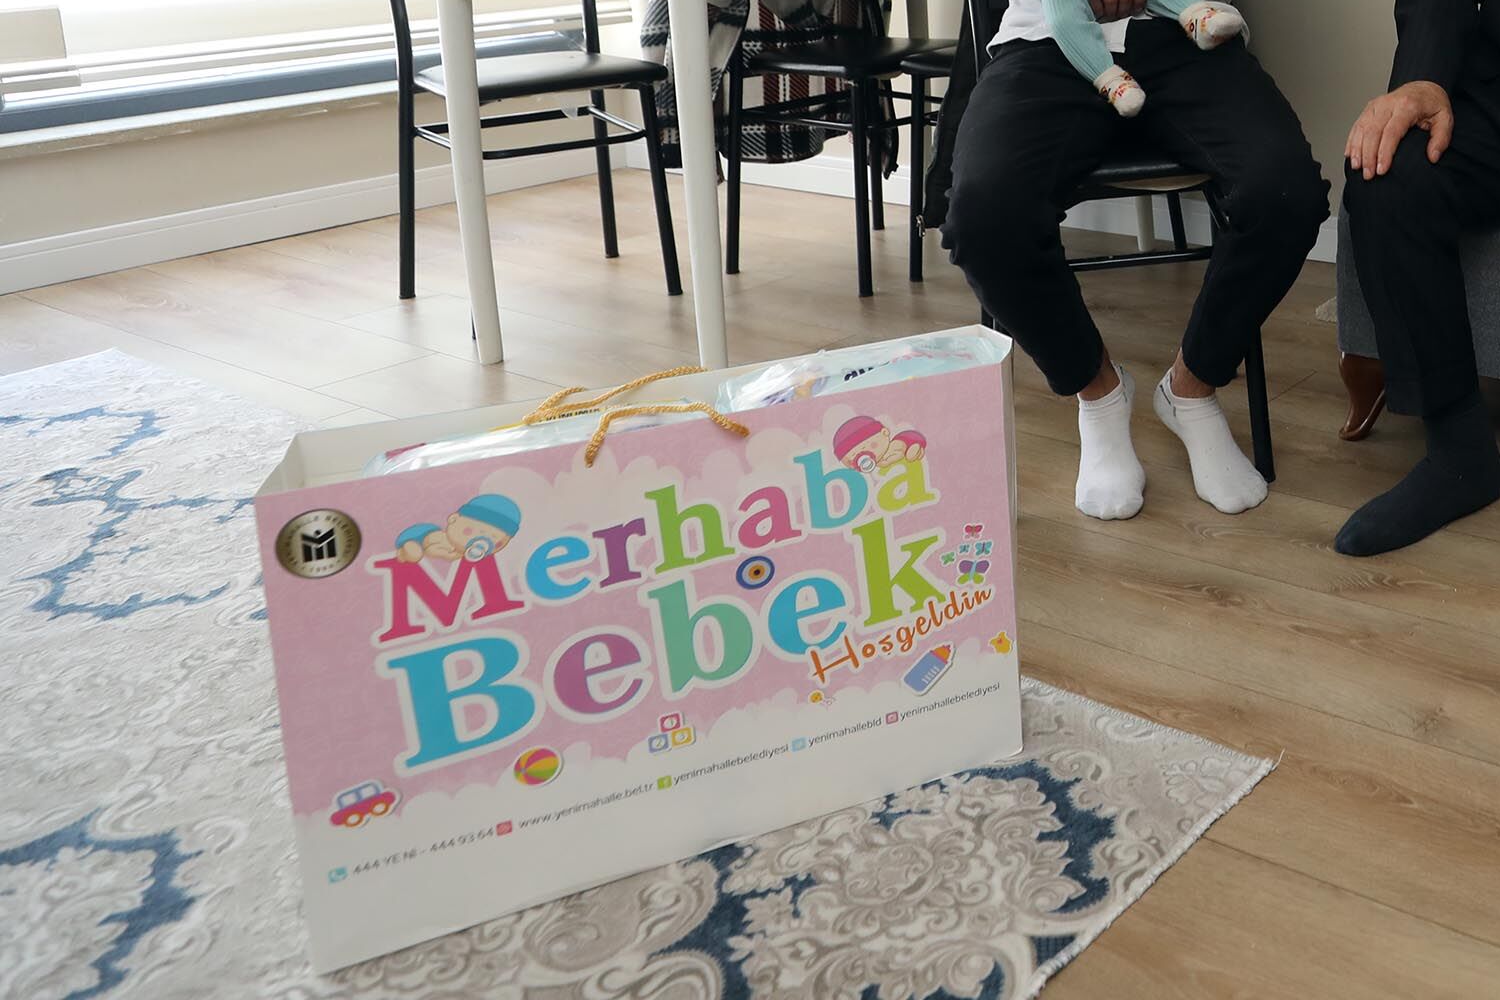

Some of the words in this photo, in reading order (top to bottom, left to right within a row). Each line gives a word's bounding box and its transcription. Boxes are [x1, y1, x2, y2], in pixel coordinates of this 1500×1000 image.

[373, 450, 936, 643] Merhaba
[386, 517, 946, 768] Bebek
[811, 585, 992, 684] Hoşgeldin
[900, 682, 1001, 721] yenimahallebelediyesi
[673, 744, 789, 786] yenimahallebelediyesi
[519, 783, 656, 829] www.yenimahalle.bel.tr
